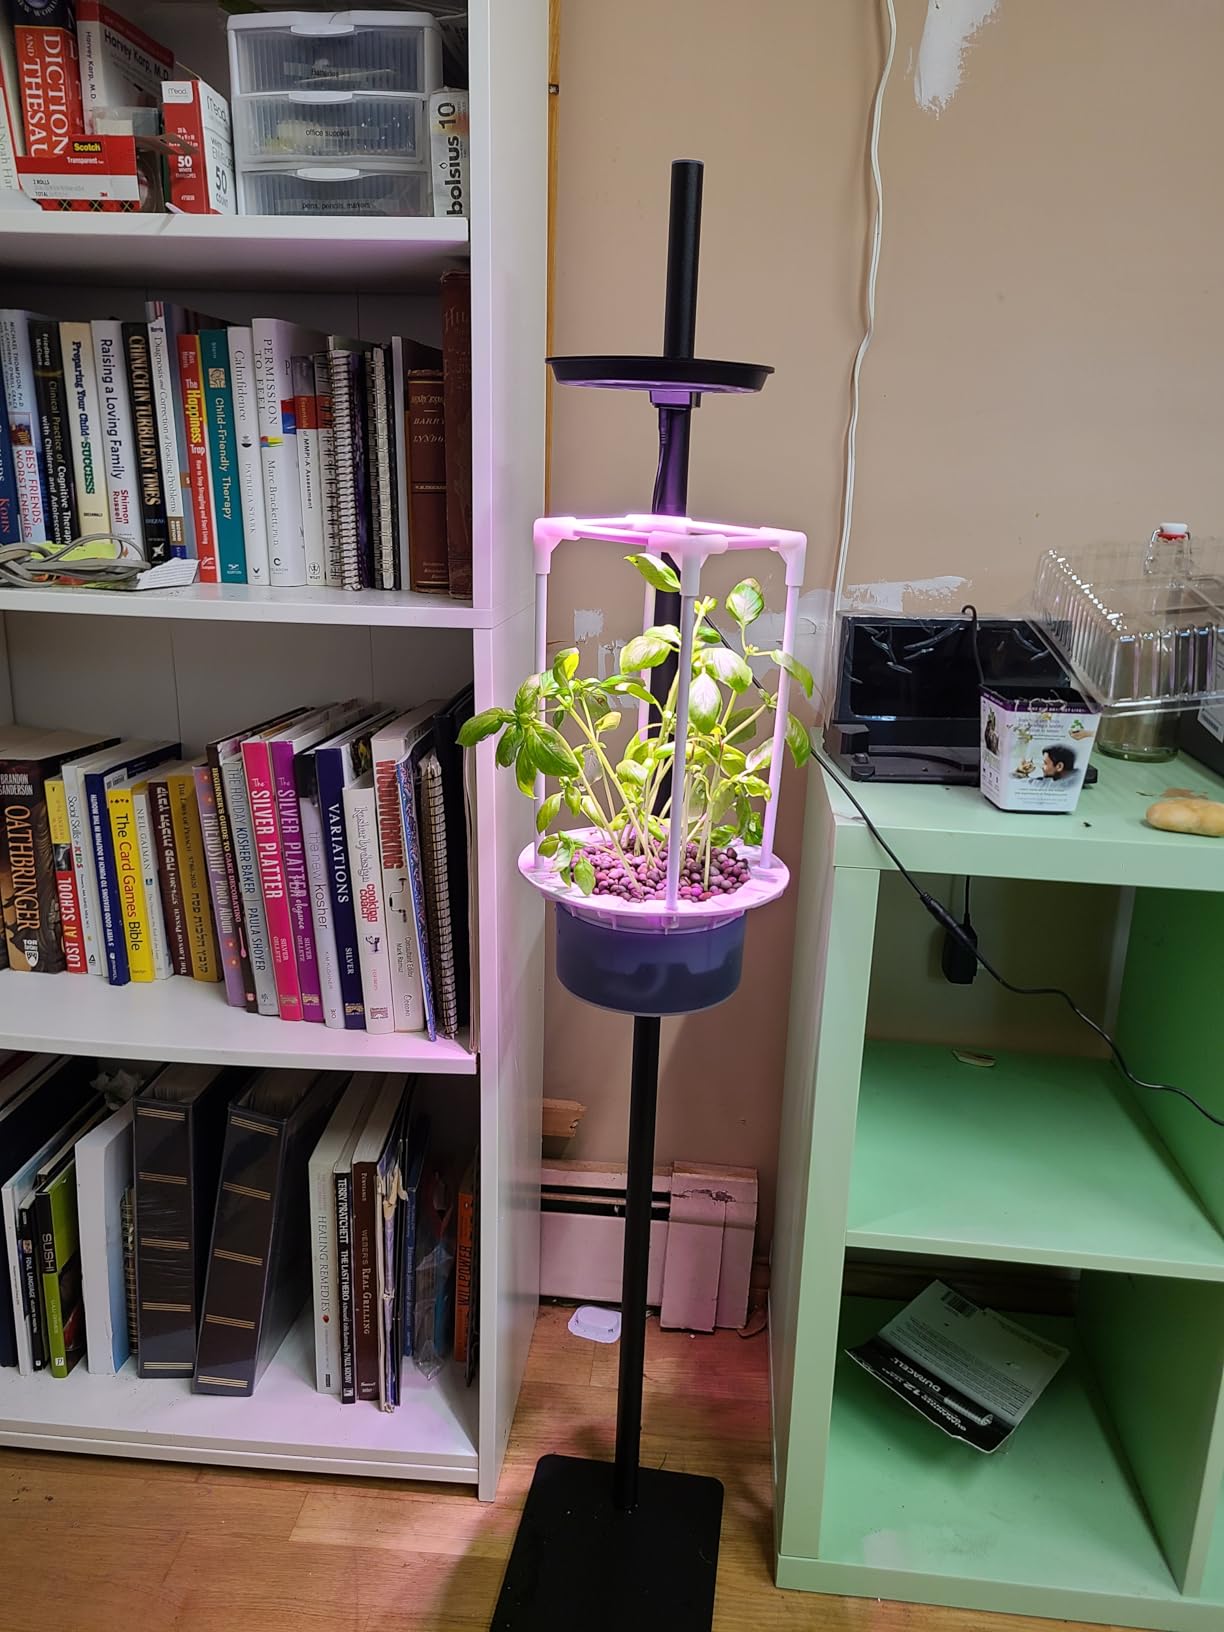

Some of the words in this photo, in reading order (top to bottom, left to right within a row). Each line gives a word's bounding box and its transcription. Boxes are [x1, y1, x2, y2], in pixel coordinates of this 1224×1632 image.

[26, 34, 35, 56] AND
[85, 31, 94, 58] Harvey
[104, 29, 131, 59] Harvey
[23, 58, 48, 157] THESAU
[43, 34, 68, 155] DICTION
[437, 102, 456, 129] 10
[74, 143, 100, 151] Scotch
[325, 130, 350, 138] supplies
[178, 156, 192, 167] 50
[440, 136, 462, 215] bolsius
[216, 167, 227, 194] 50
[10, 321, 18, 351] MICHAEL
[41, 333, 51, 366] Friedberg
[72, 341, 85, 388] Preparing
[100, 339, 115, 384] Raising
[128, 335, 152, 389] CHINUCH
[154, 336, 166, 378] Diagnosis
[255, 351, 263, 370] TO
[133, 390, 154, 402] IN
[186, 378, 199, 389] The
[233, 350, 248, 421] Calmfidence
[263, 338, 278, 425] PERMISSION
[47, 381, 59, 414] Clinical
[77, 390, 87, 411] Your
[159, 391, 171, 434] Correction
[41, 415, 49, 435] with
[80, 413, 91, 436] Child
[106, 397, 120, 437] Loving
[186, 390, 203, 443] Happiness
[52, 417, 62, 450] Practice
[135, 405, 160, 470] TURBULENT
[214, 397, 230, 472] Child-Friendly
[15, 450, 26, 489] WORST
[25, 450, 35, 474] BEST
[44, 439, 54, 474] Children
[56, 454, 64, 464] of
[81, 441, 96, 494] SUCCESS
[109, 440, 125, 480] Family
[162, 441, 175, 475] Reading
[48, 477, 57, 493] and
[57, 466, 69, 508] Cognitive
[244, 463, 254, 504] PATRICIA
[267, 460, 277, 484] Marc
[27, 480, 41, 526] FRIENDS,
[142, 472, 161, 506] TIMES
[167, 475, 179, 513] Problems
[197, 487, 207, 510] Struggling
[221, 476, 233, 520] Therapy
[305, 469, 313, 510] Assessment
[20, 493, 32, 538] ENEMIES
[50, 496, 62, 544] Adolescents
[113, 490, 123, 523] Russell
[121, 489, 130, 524] Shimon
[248, 507, 257, 534] STARK
[268, 486, 279, 528] Brackett,
[62, 511, 73, 545] Therapy
[0, 773, 29, 785] BRANDON
[0, 784, 33, 796] SANDERSON
[211, 767, 224, 814] BEGINNER'S
[228, 768, 241, 784] THE
[252, 778, 265, 788] The
[67, 796, 80, 818] Social
[91, 794, 99, 814] MOUTH
[156, 787, 169, 811] קובץ
[231, 787, 245, 824] HOLIDAY
[251, 790, 275, 835] SILVER
[277, 789, 299, 833] SILVER
[70, 820, 81, 839] Skills
[116, 813, 130, 837] The
[137, 809, 146, 831] NEIL
[217, 815, 228, 840] GUIDE
[353, 807, 370, 838] kosher
[375, 760, 404, 870] WOODWORKING
[96, 833, 104, 856] DOLPHIN
[161, 814, 174, 847] הלכות
[236, 827, 251, 862] KOSHER
[308, 832, 322, 851] the
[74, 846, 83, 869] KIDS
[120, 841, 133, 871] Card
[139, 833, 151, 871] GAIMAN
[164, 849, 176, 870] פסח
[223, 841, 230, 852] TO
[328, 803, 349, 904] VARIATIONS
[4, 805, 41, 932] OATHBRINGER
[99, 861, 107, 879] PUNCH
[224, 853, 234, 874] CAKE
[258, 843, 282, 898] PLATTER
[284, 842, 307, 897] PLATTER
[311, 852, 325, 880] new
[214, 880, 228, 905] Photo
[241, 865, 255, 894] BAKER
[59, 877, 75, 920] SCHOOL
[103, 888, 111, 911] REASONS
[122, 875, 137, 917] Games
[191, 893, 201, 913] פסח
[228, 876, 241, 923] DECORATING
[314, 883, 330, 929] kosher
[359, 888, 370, 921] coach
[366, 884, 380, 923] cooking
[63, 922, 77, 938] AT
[106, 929, 114, 942] VERY
[173, 908, 182, 933] PESACH
[194, 916, 207, 947] הלכות
[218, 908, 233, 934] Album
[247, 908, 260, 935] PAULA
[129, 921, 143, 951] Bible
[280, 938, 289, 961] SILVER
[304, 937, 313, 960] SILVER
[404, 936, 412, 962] Consultant
[66, 942, 81, 968] LOST
[177, 943, 186, 960] LAWS
[179, 960, 187, 973] THE
[198, 951, 209, 973] קובץ
[253, 938, 266, 971] SHOYER
[345, 948, 355, 974] SILVER
[337, 1178, 348, 1201] TERRY
[338, 1202, 349, 1244] PRATCHETT
[42, 1233, 55, 1271] SUSHI
[318, 1216, 329, 1261] HEALING
[340, 1251, 349, 1264] THE
[341, 1265, 349, 1280] LAST
[27, 1272, 35, 1299] LANGUAGE
[320, 1264, 330, 1312] REMEDIES
[362, 1268, 371, 1290] REAL
[457, 1244, 472, 1306] WILLPOWER
[342, 1282, 350, 1300] HERO
[362, 1292, 372, 1335] GRILLING
[343, 1353, 352, 1367] PAUL
[344, 1367, 353, 1383] KIDBY
[890, 1357, 942, 1393] DURACELL
[903, 1380, 921, 1396] 12
